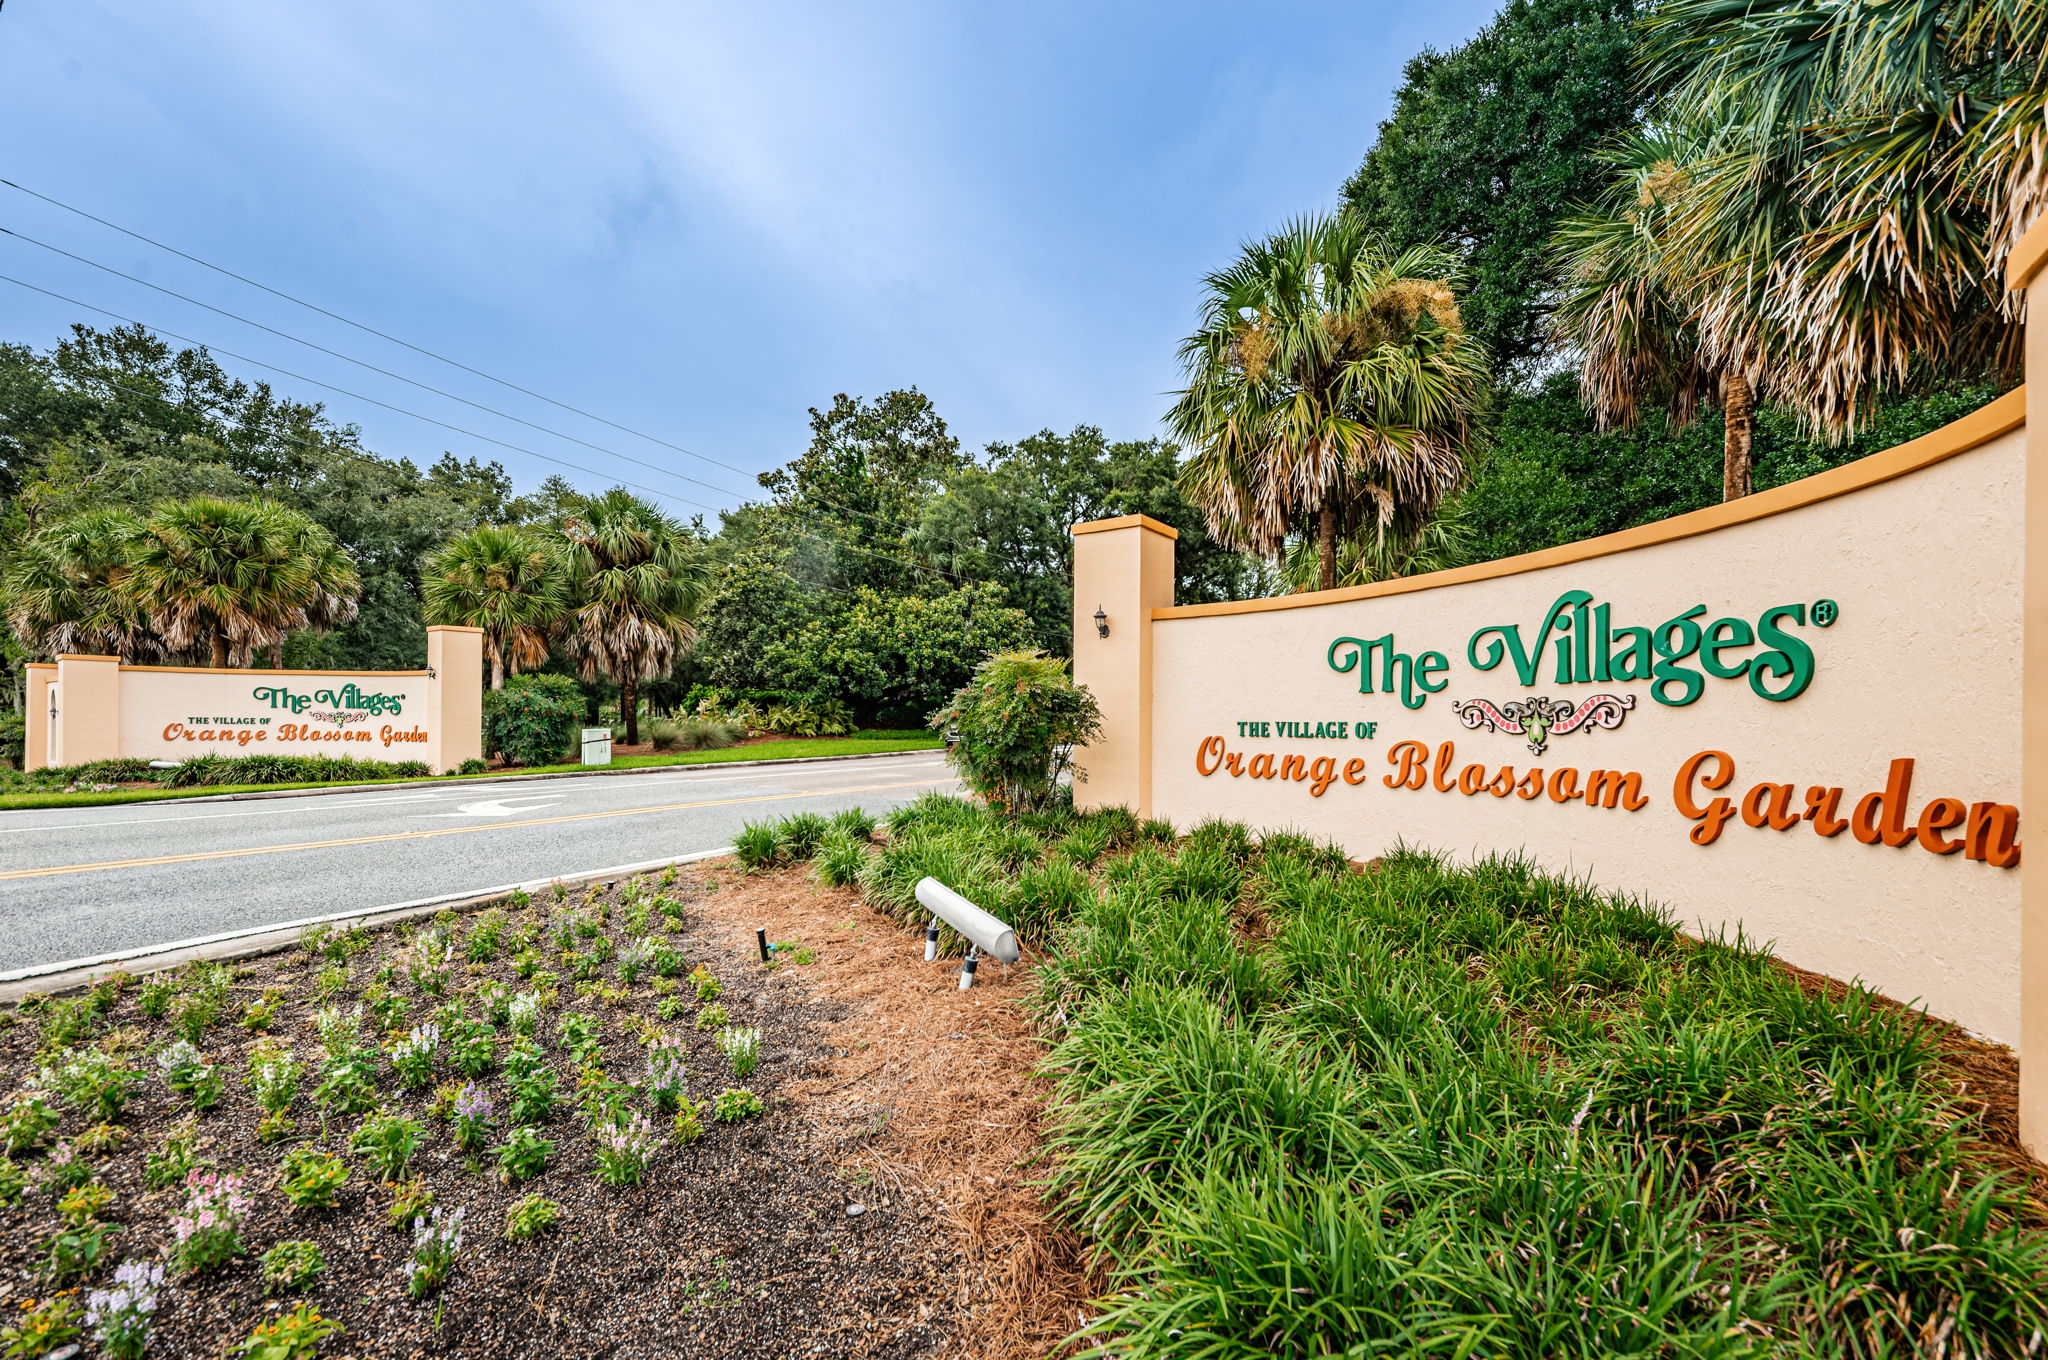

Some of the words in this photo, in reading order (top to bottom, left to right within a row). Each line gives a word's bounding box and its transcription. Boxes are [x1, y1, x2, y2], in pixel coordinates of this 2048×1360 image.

[1327, 633, 1450, 709] The
[253, 686, 311, 714] The
[188, 716, 210, 725] THE
[212, 716, 256, 725] VILLAGE
[259, 717, 272, 726] OF
[1236, 721, 1271, 738] THE
[1275, 721, 1349, 739] VILLAGE
[1354, 721, 1379, 739] OF
[162, 722, 267, 747] Orange
[276, 723, 372, 742] Blossom
[1195, 735, 1366, 797] Orange
[1382, 739, 1650, 811] Blossom
[1673, 750, 2022, 868] Garden
